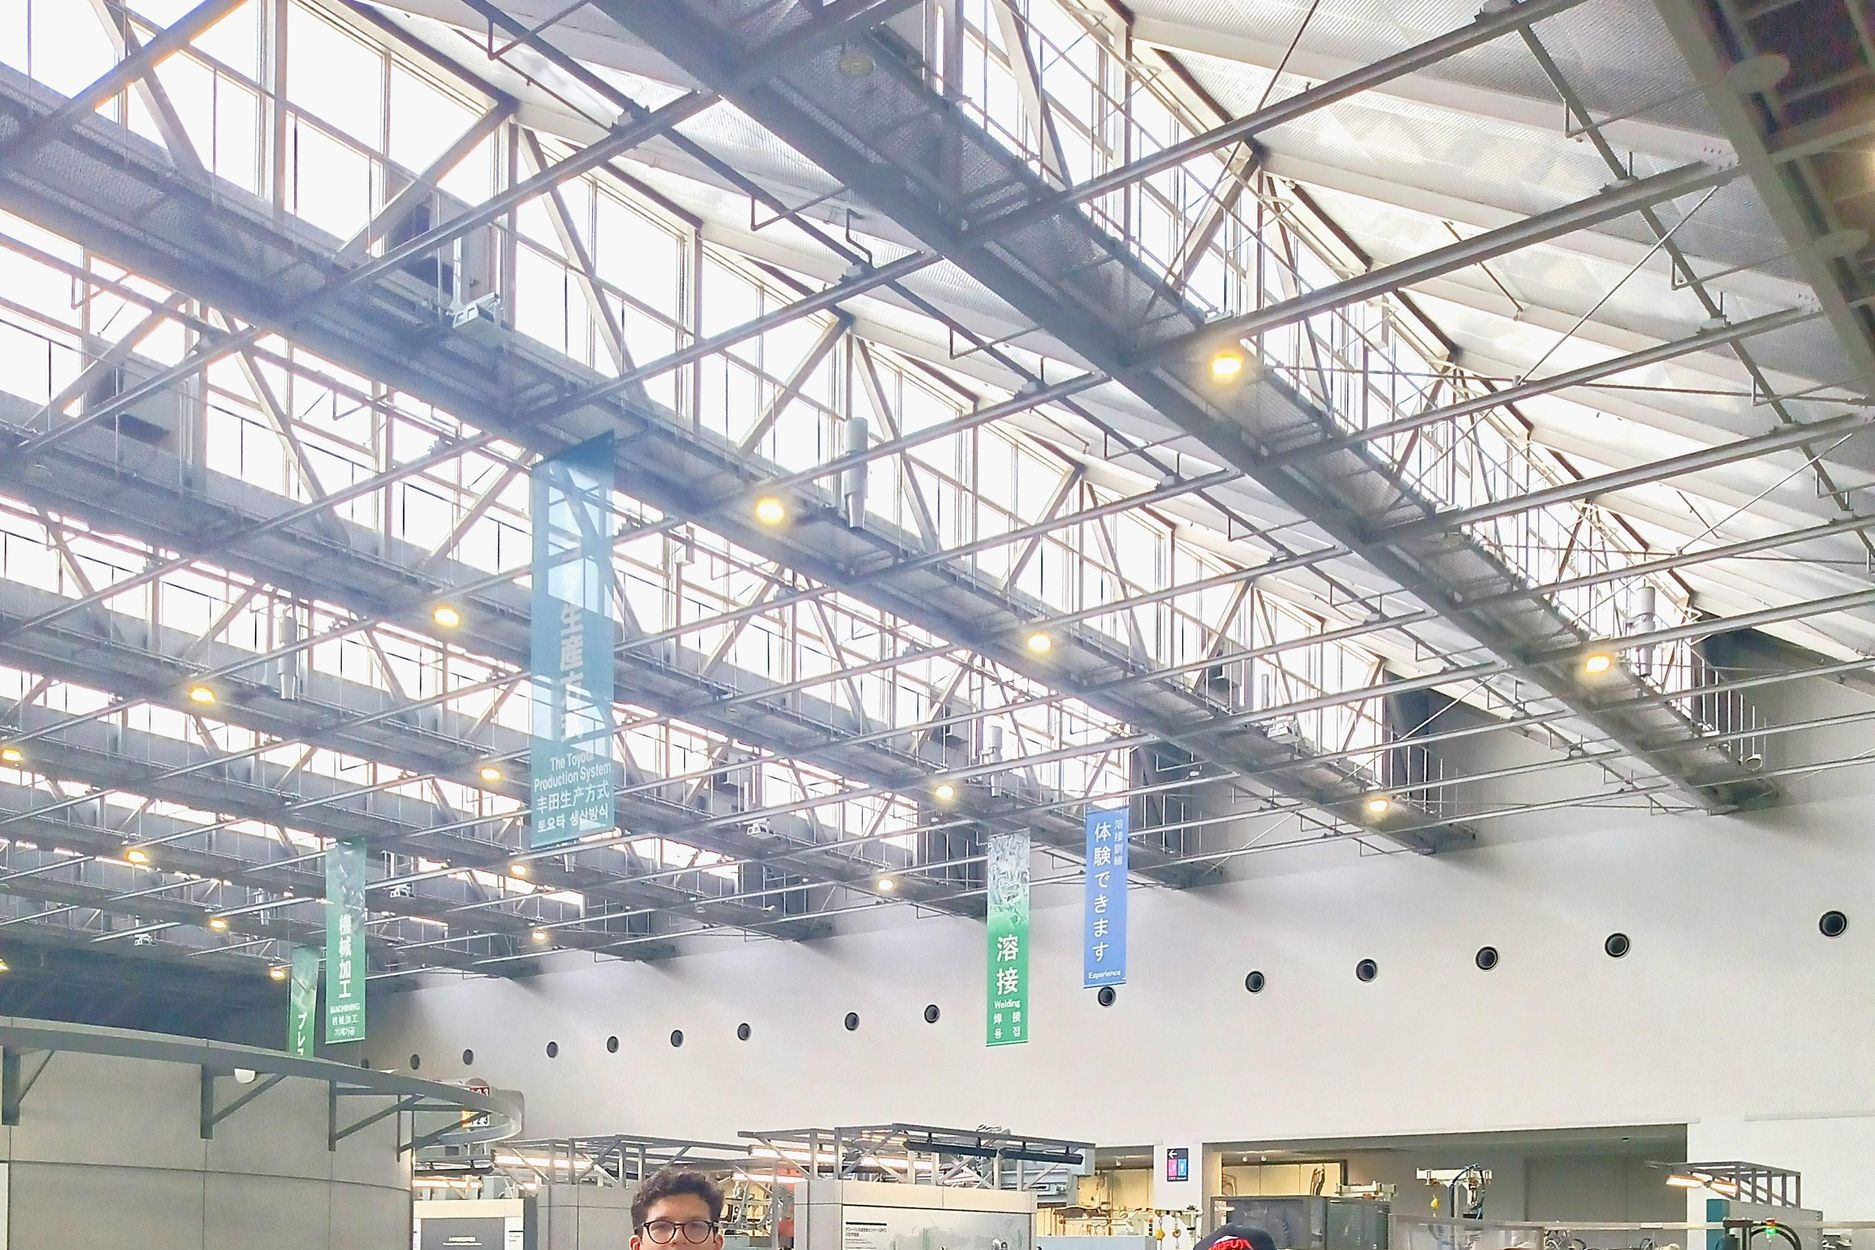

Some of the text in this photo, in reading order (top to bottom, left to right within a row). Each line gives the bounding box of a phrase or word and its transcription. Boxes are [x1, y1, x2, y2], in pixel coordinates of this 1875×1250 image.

[550, 749, 594, 772] The Toyota
[534, 762, 612, 792] Production System
[536, 779, 610, 814] 丰田生产方式
[537, 813, 566, 833] 토요타
[1092, 822, 1112, 963] 体験できます
[996, 933, 1019, 996] 溶接
[1088, 969, 1121, 980] Experience
[993, 999, 1021, 1009] Welding
